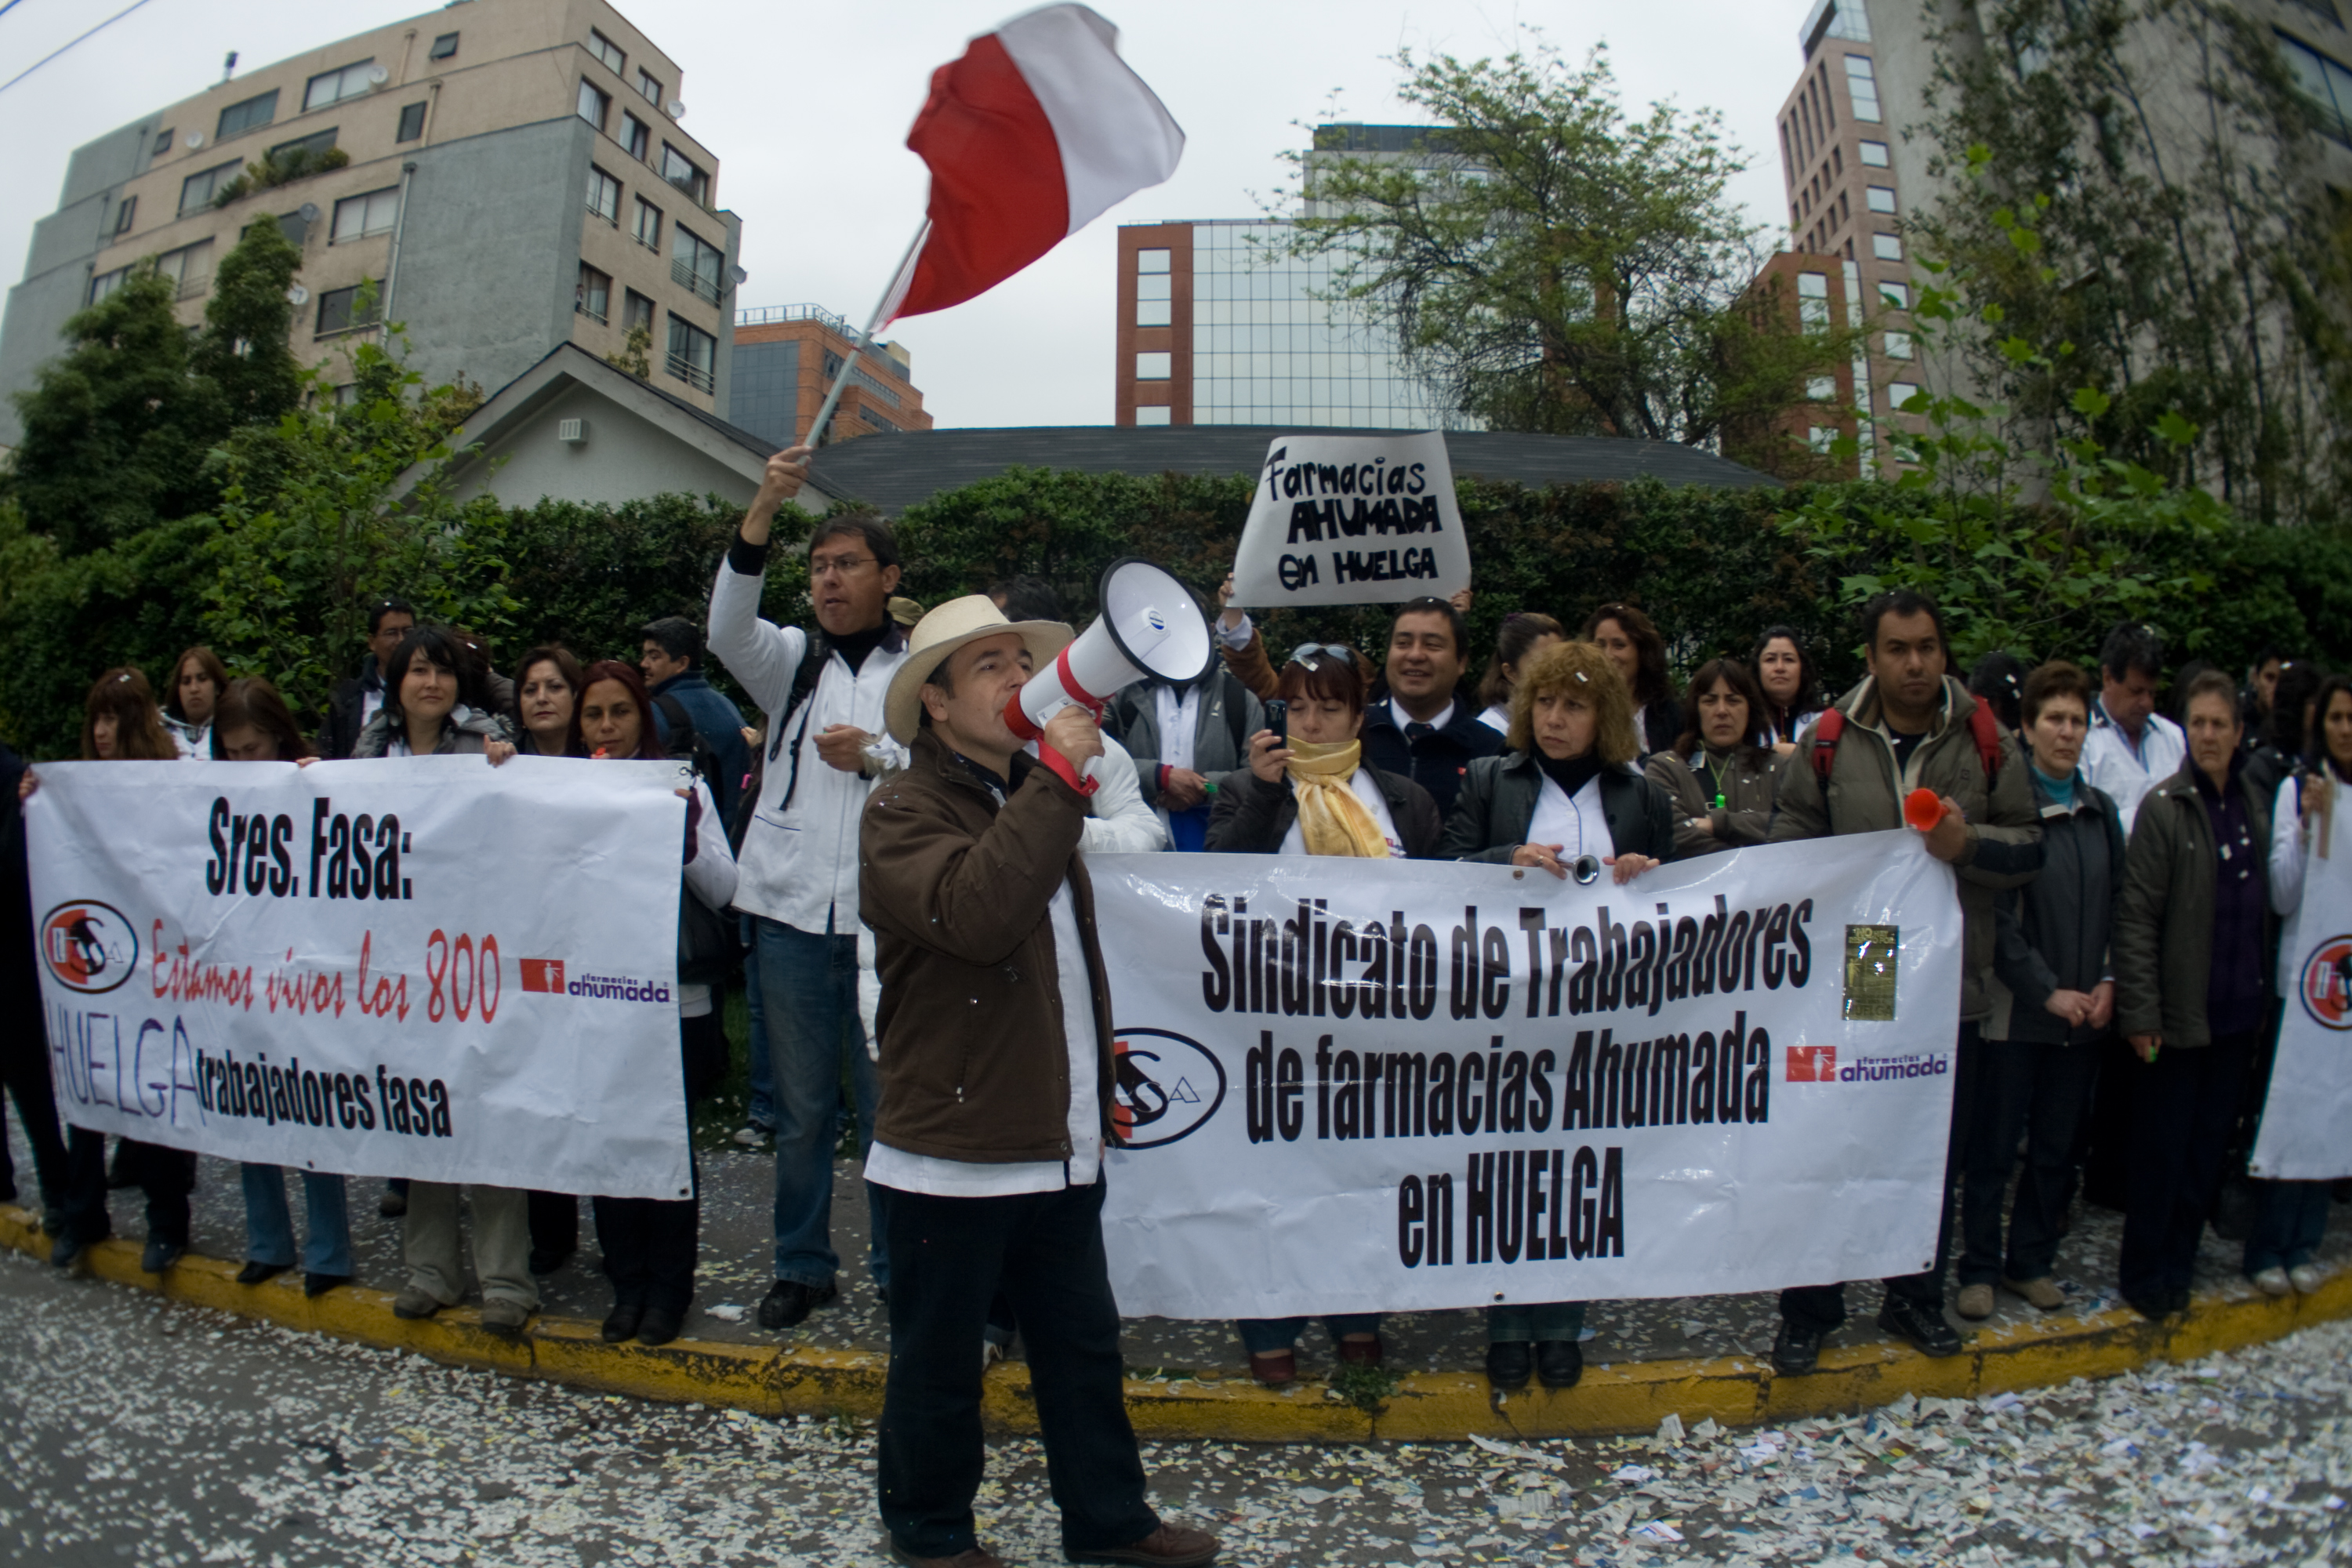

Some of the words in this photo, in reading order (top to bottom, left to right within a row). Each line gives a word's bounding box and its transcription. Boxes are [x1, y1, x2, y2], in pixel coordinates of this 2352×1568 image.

[1265, 446, 1425, 501] Farmacias
[1287, 495, 1443, 544] AHUMADA
[1279, 554, 1320, 591] en
[1332, 547, 1439, 584] HUELGA
[206, 797, 298, 898] Sres.
[310, 797, 413, 900] Fasa:
[152, 918, 254, 1014] Estamos
[266, 947, 346, 1018] vivos
[358, 930, 410, 1022] los
[426, 929, 501, 1024] 800
[568, 975, 670, 1003] ahumada
[1201, 894, 1436, 1020] Sindicato
[1450, 906, 1510, 1019] de
[1517, 894, 1813, 1018] Trabajadores
[46, 998, 206, 1127] HUELGA
[195, 1049, 377, 1131] trabajadores
[377, 1064, 453, 1138] fasa
[1245, 1031, 1301, 1144] de
[1316, 1034, 1555, 1140] farmacias
[1563, 1010, 1771, 1131] Ahumada
[1840, 1054, 1948, 1082] ahumada
[1398, 1170, 1454, 1269] en
[1466, 1145, 1624, 1264] HUELGA
